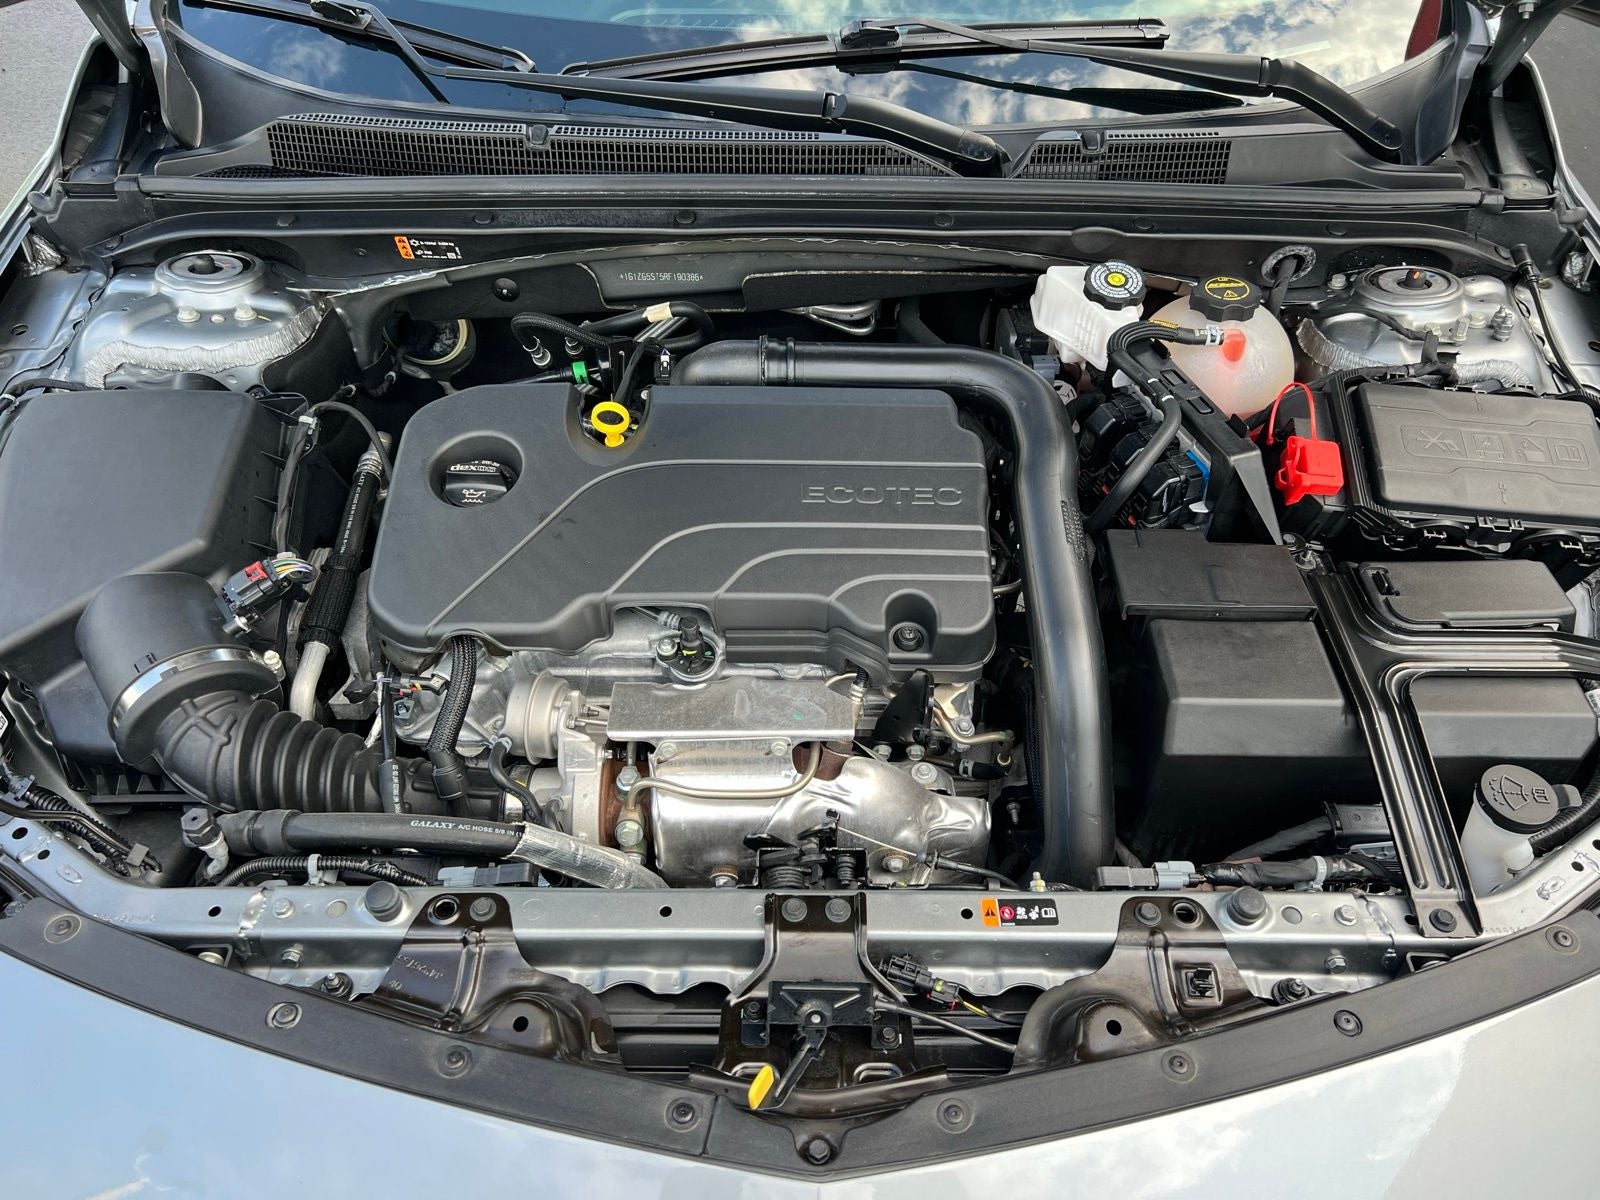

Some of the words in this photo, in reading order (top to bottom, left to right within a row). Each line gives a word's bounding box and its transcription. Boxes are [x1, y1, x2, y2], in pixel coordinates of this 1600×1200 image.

[358, 472, 366, 486] LAXY
[801, 486, 963, 506] ECOTEC
[410, 820, 456, 829] GALAXY
